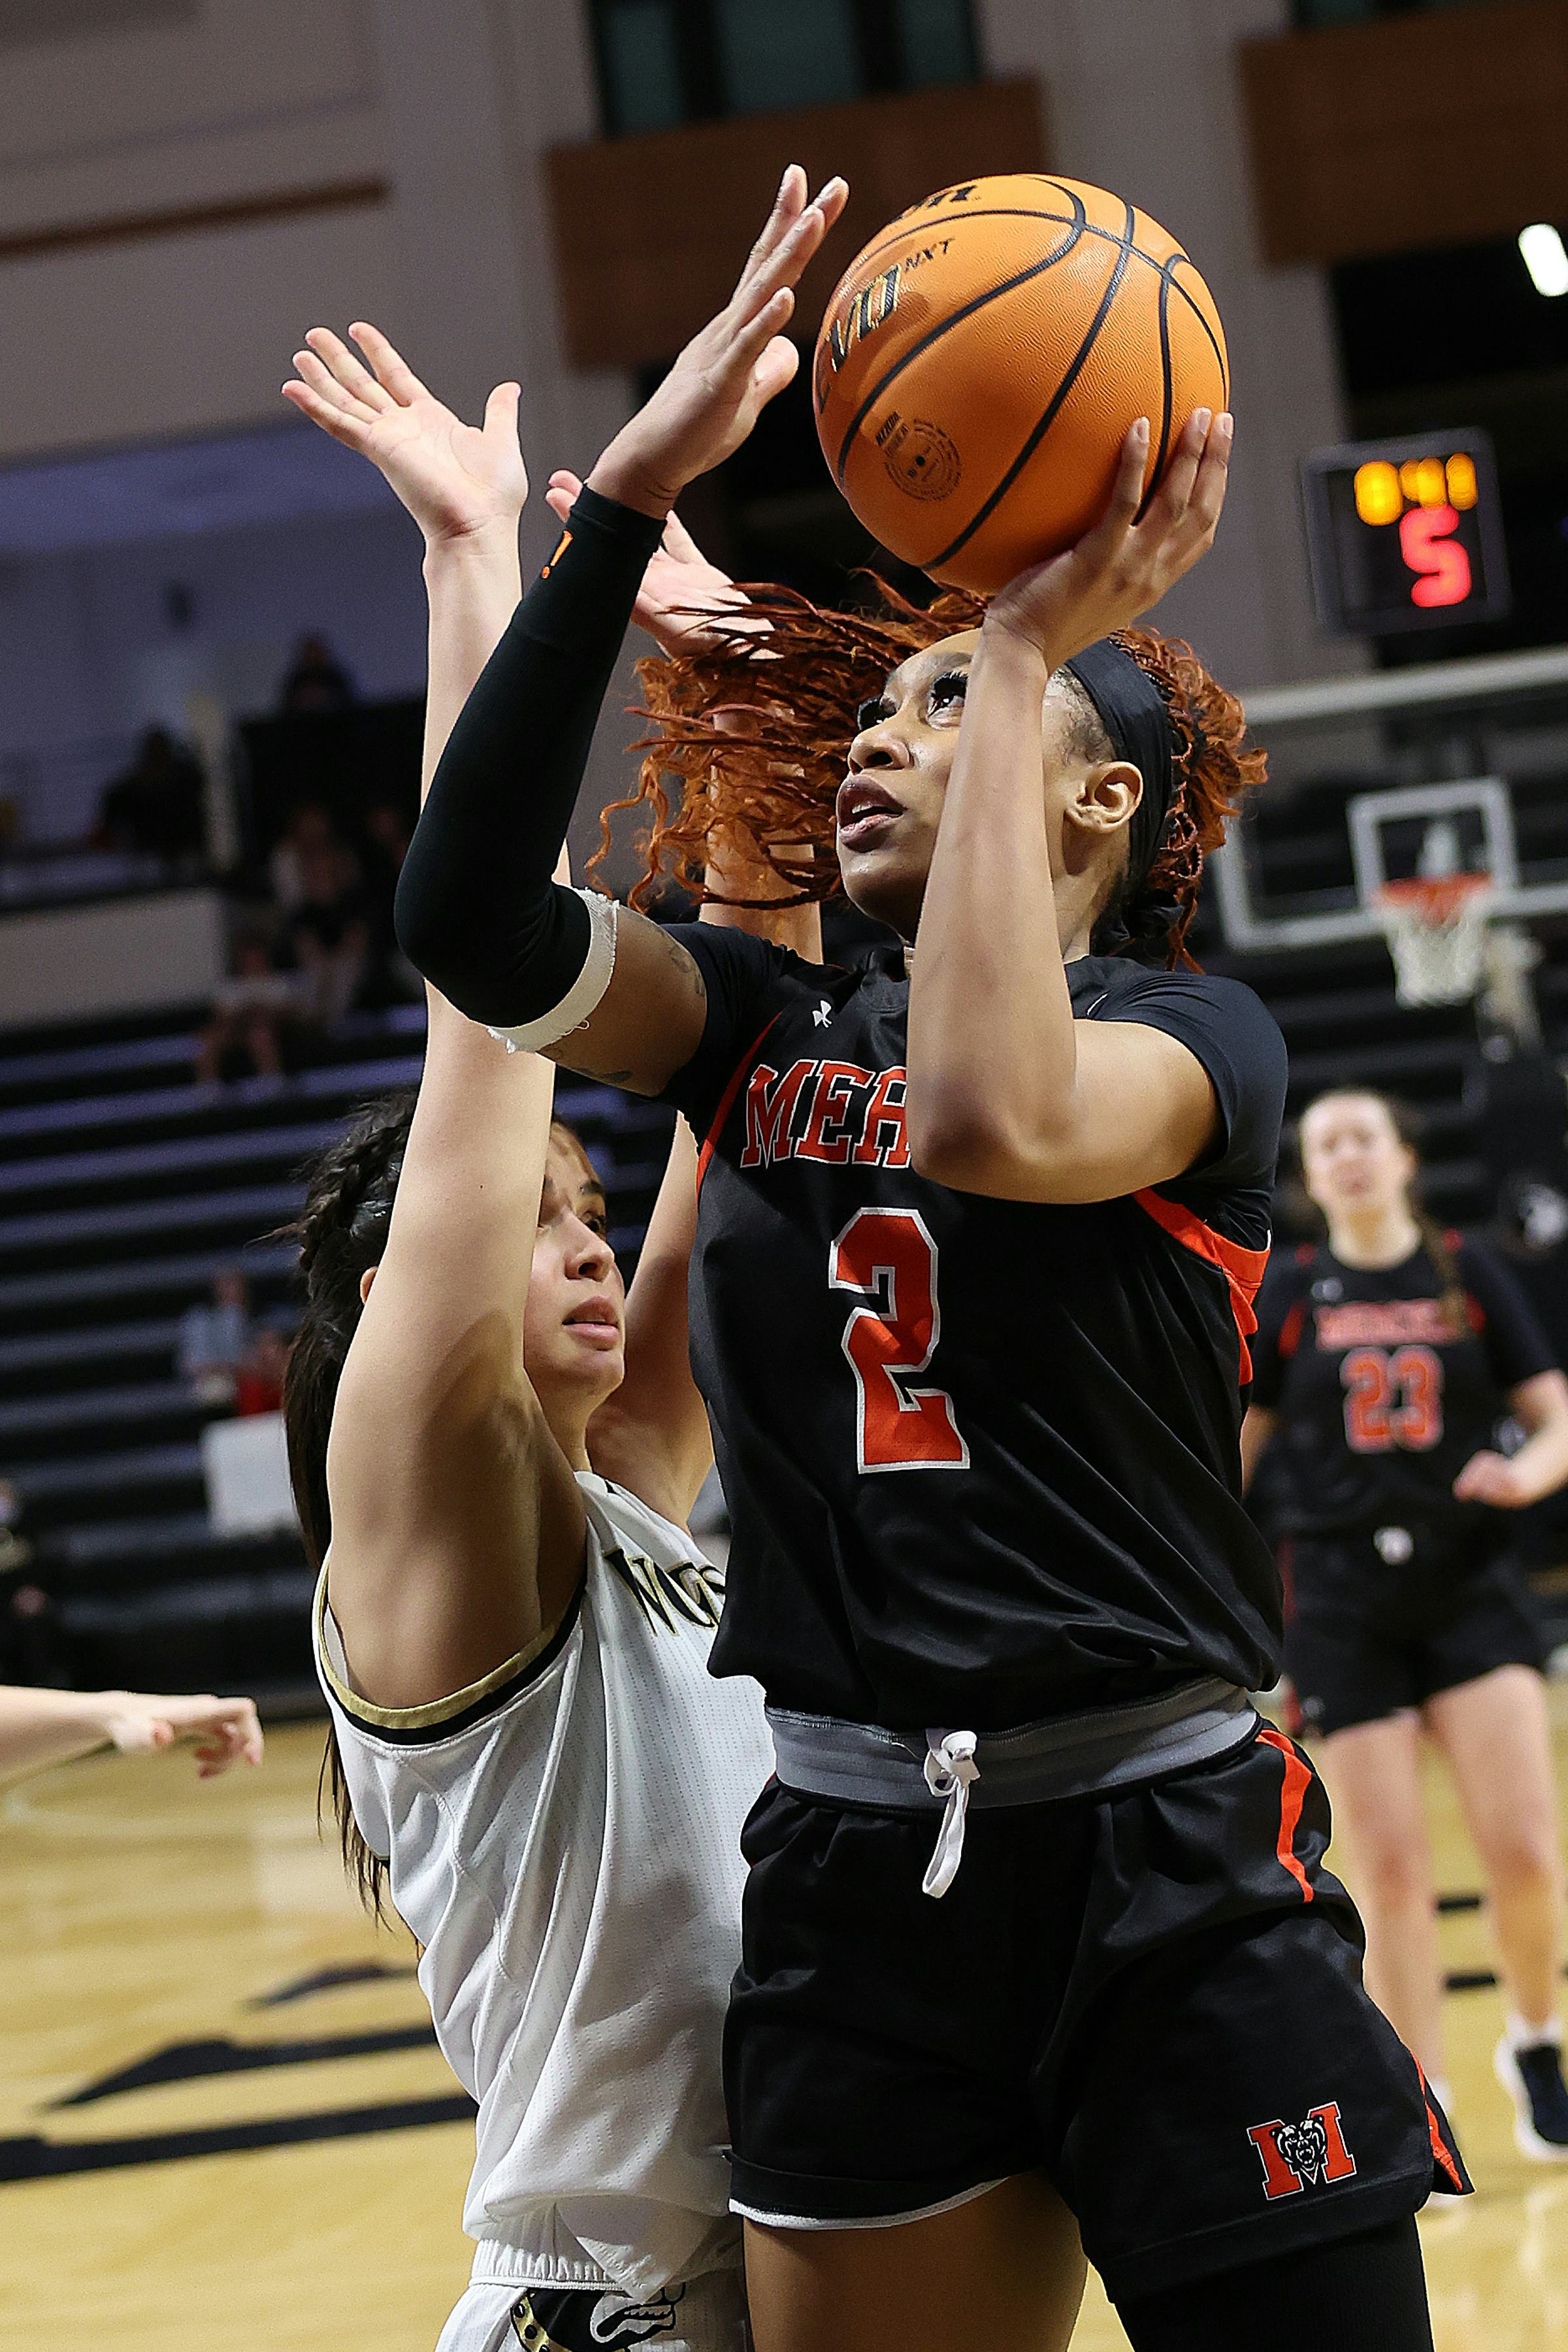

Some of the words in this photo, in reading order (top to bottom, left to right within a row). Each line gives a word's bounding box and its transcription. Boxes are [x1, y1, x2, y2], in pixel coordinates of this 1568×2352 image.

[1399, 504, 1471, 607] 5
[828, 1207, 970, 1474] 2
[1340, 1344, 1445, 1454] 23
[1246, 2100, 1357, 2200] M
